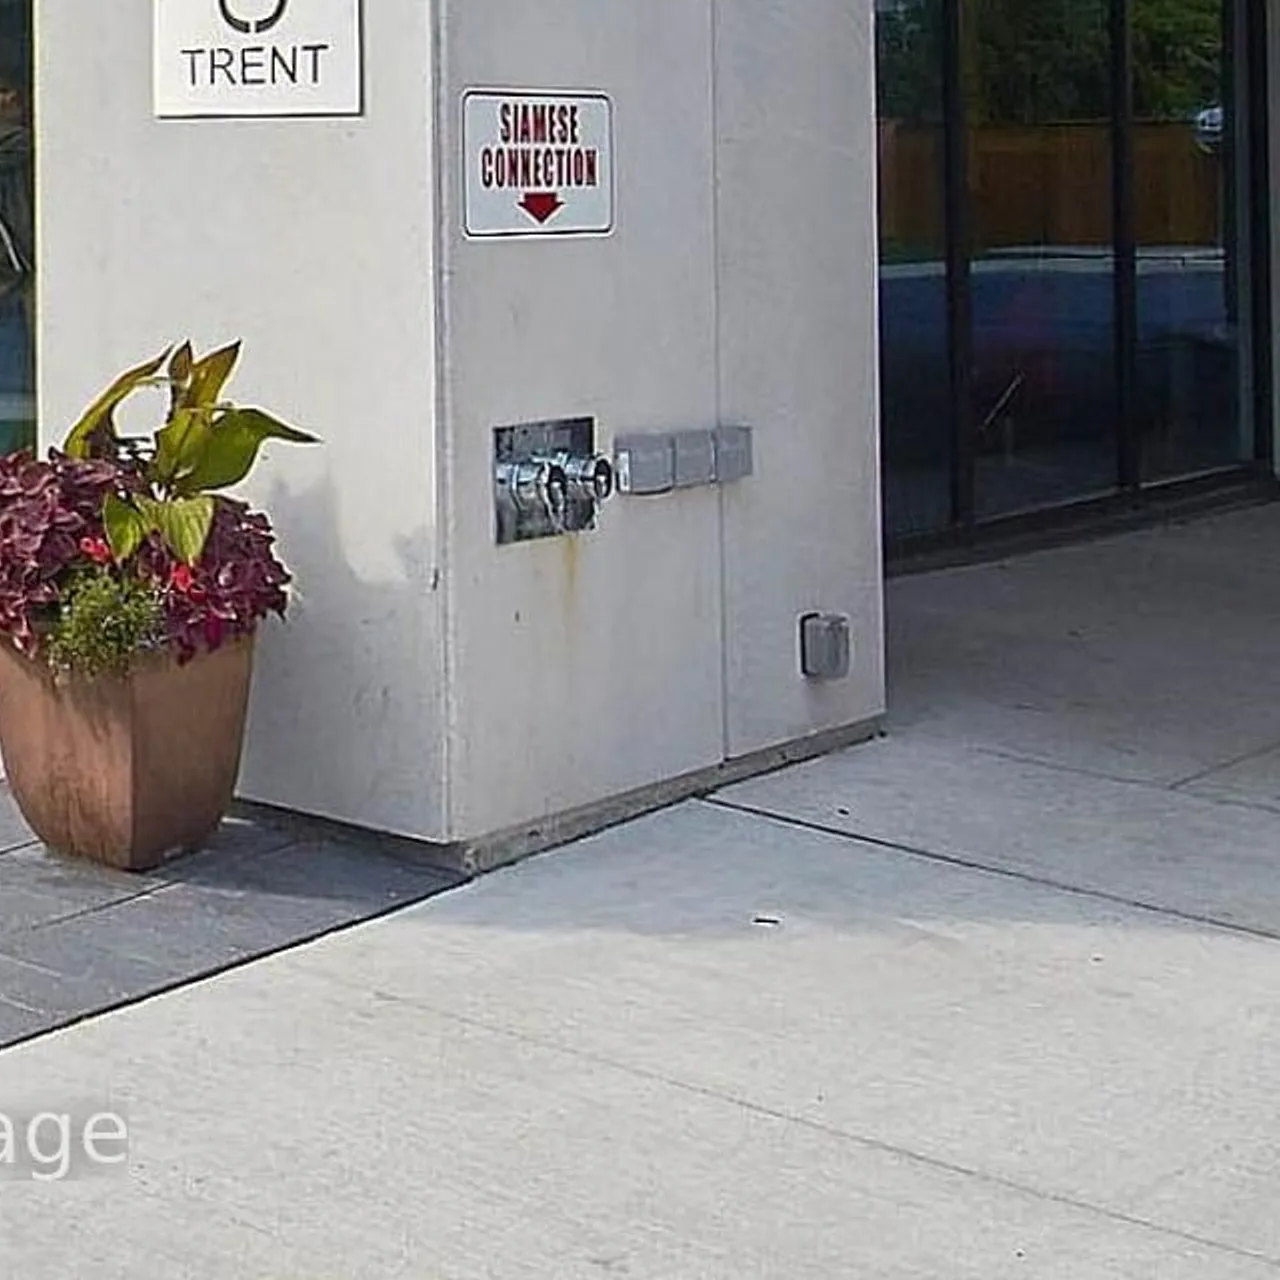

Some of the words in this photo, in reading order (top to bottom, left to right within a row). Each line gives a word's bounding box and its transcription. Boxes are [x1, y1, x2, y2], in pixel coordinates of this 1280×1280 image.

[180, 44, 329, 86] TRENT
[500, 103, 578, 144] SIAMESE
[481, 147, 597, 188] CONNECTION
